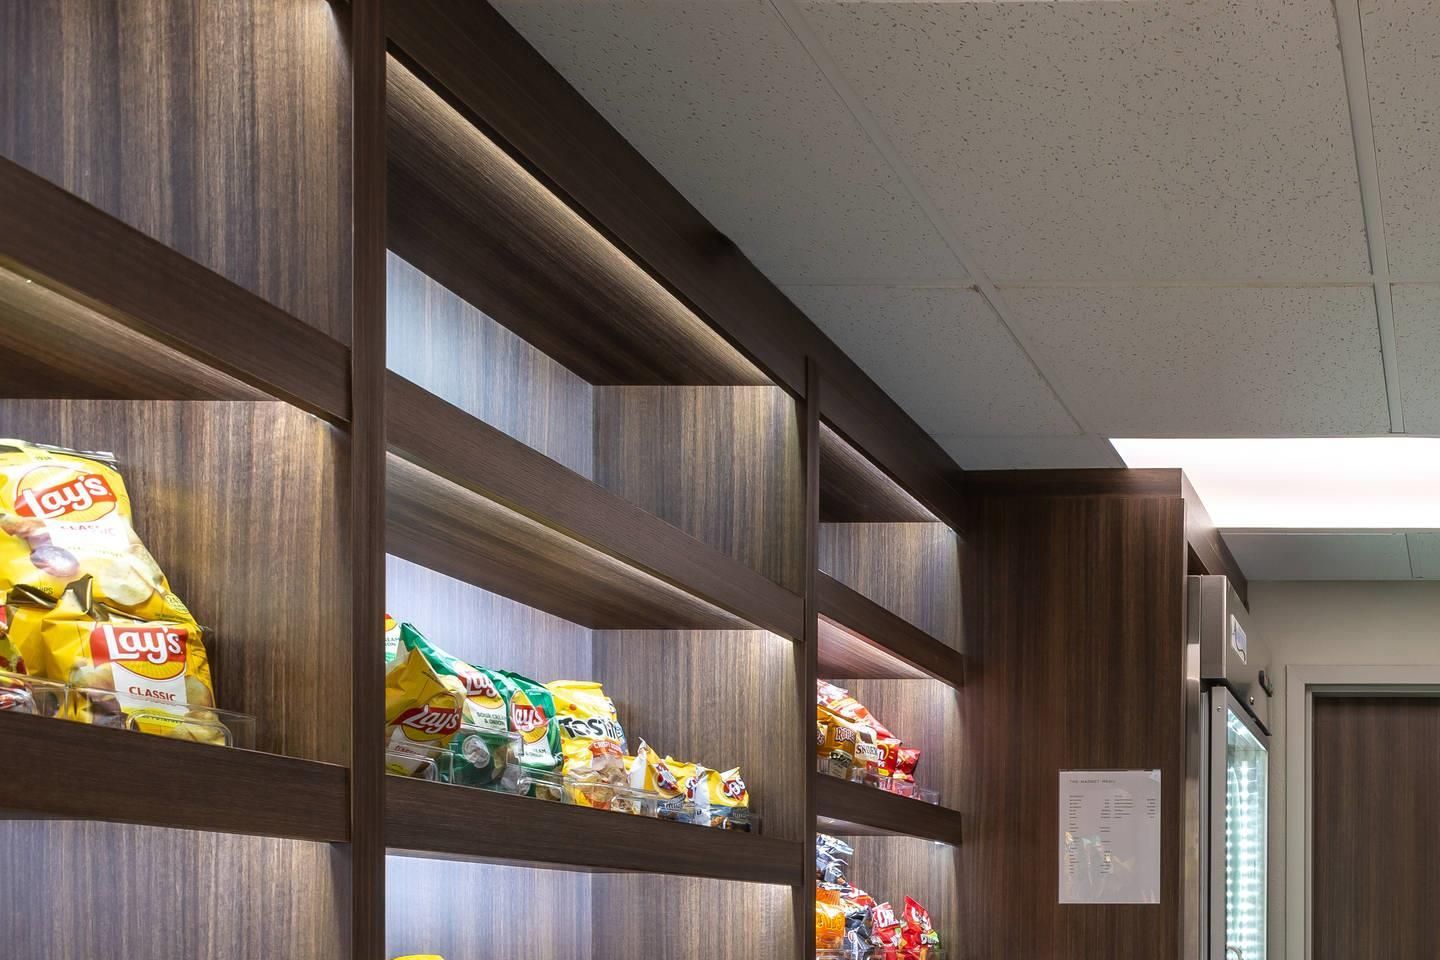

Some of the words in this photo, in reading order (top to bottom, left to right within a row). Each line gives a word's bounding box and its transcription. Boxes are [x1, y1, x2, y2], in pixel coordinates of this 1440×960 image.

[22, 475, 112, 519] Lay's
[103, 624, 184, 664] Lay's
[128, 686, 177, 702] CLASSIC
[402, 704, 460, 734] Lay's
